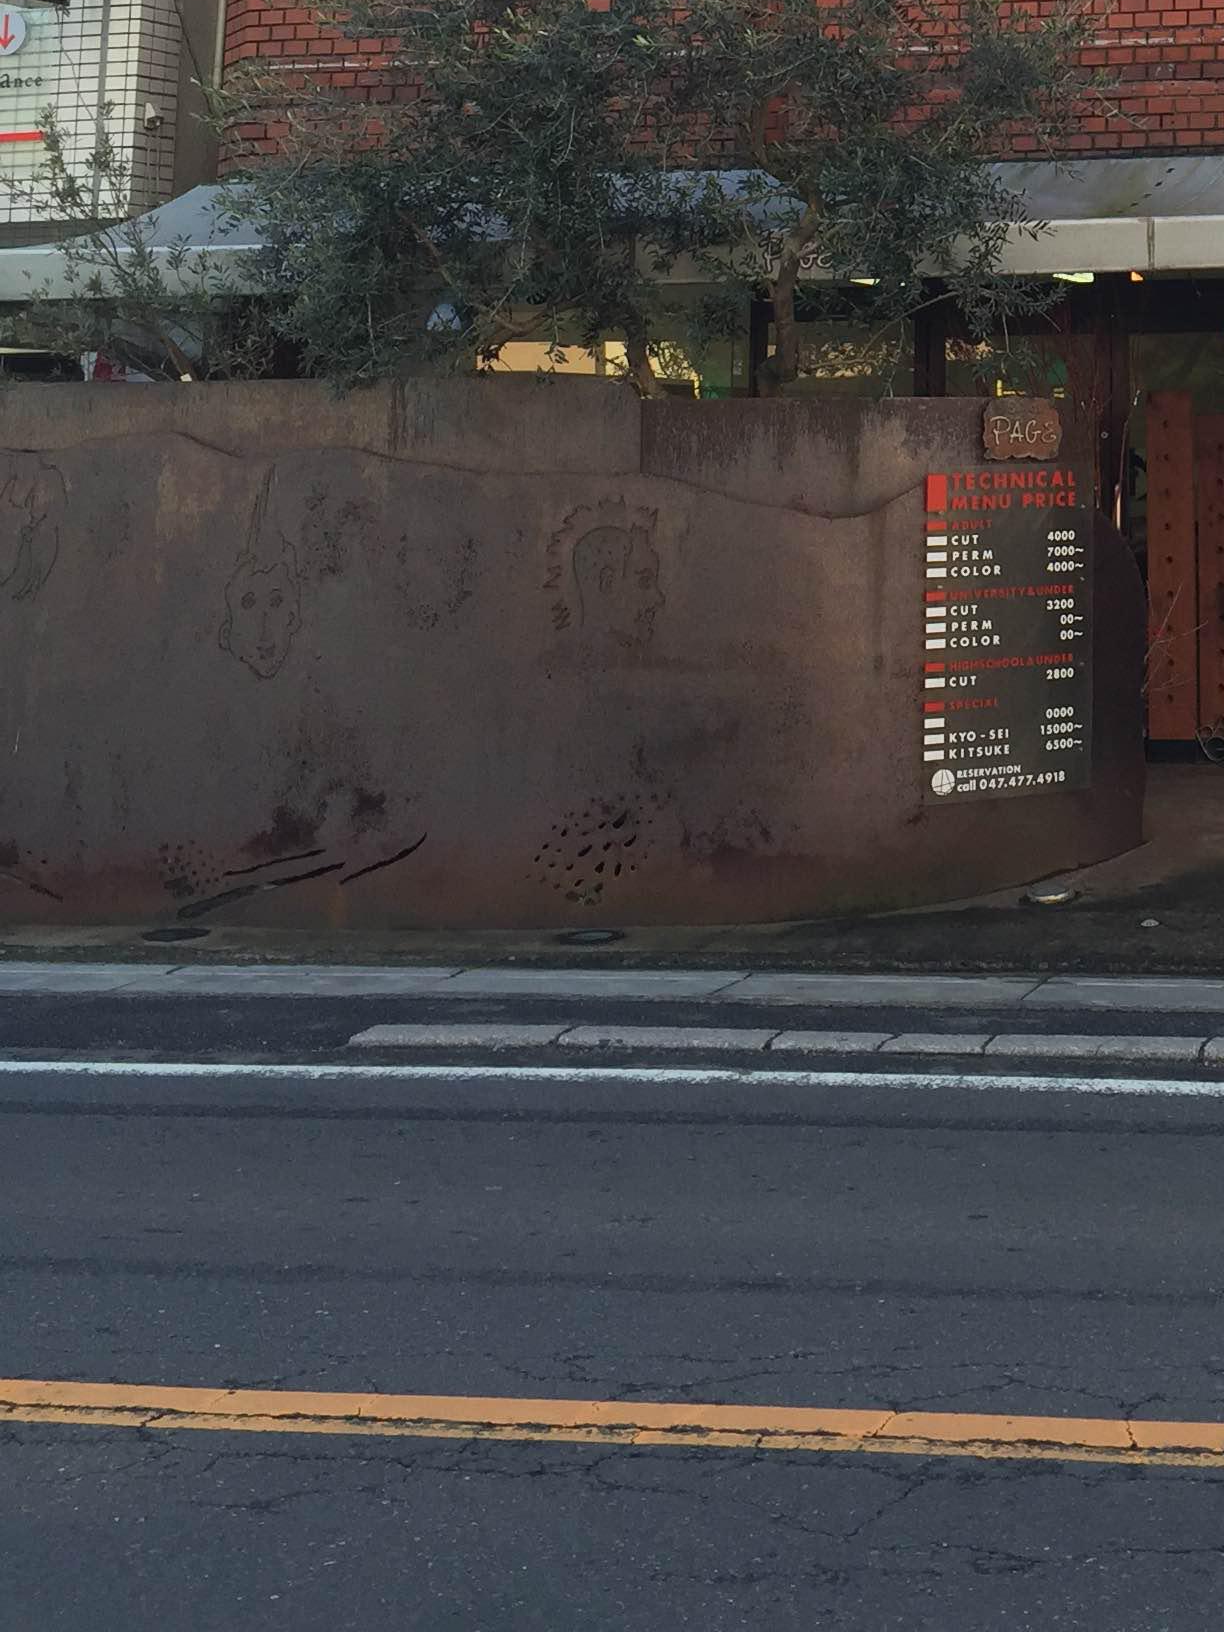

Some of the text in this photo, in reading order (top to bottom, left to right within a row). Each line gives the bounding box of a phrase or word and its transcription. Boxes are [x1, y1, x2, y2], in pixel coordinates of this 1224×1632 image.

[990, 415, 1057, 445] PAGE
[952, 470, 1076, 490] TECHNICAL
[952, 491, 1077, 511] MENU PRICE
[951, 519, 993, 530] ADULT
[951, 530, 1076, 545] CUT 4000
[952, 549, 993, 561] PERM
[950, 564, 1002, 577] COLOR
[950, 599, 1074, 616] CUT 3200
[951, 620, 992, 632] PERM
[950, 635, 1000, 648] COLOR
[949, 667, 1074, 687] CUT 2800
[1045, 706, 1074, 718] 0000
[949, 744, 1010, 759] KITSUKE
[956, 765, 1022, 779] RESERVATION
[957, 770, 1066, 793] call 047.477.4918
